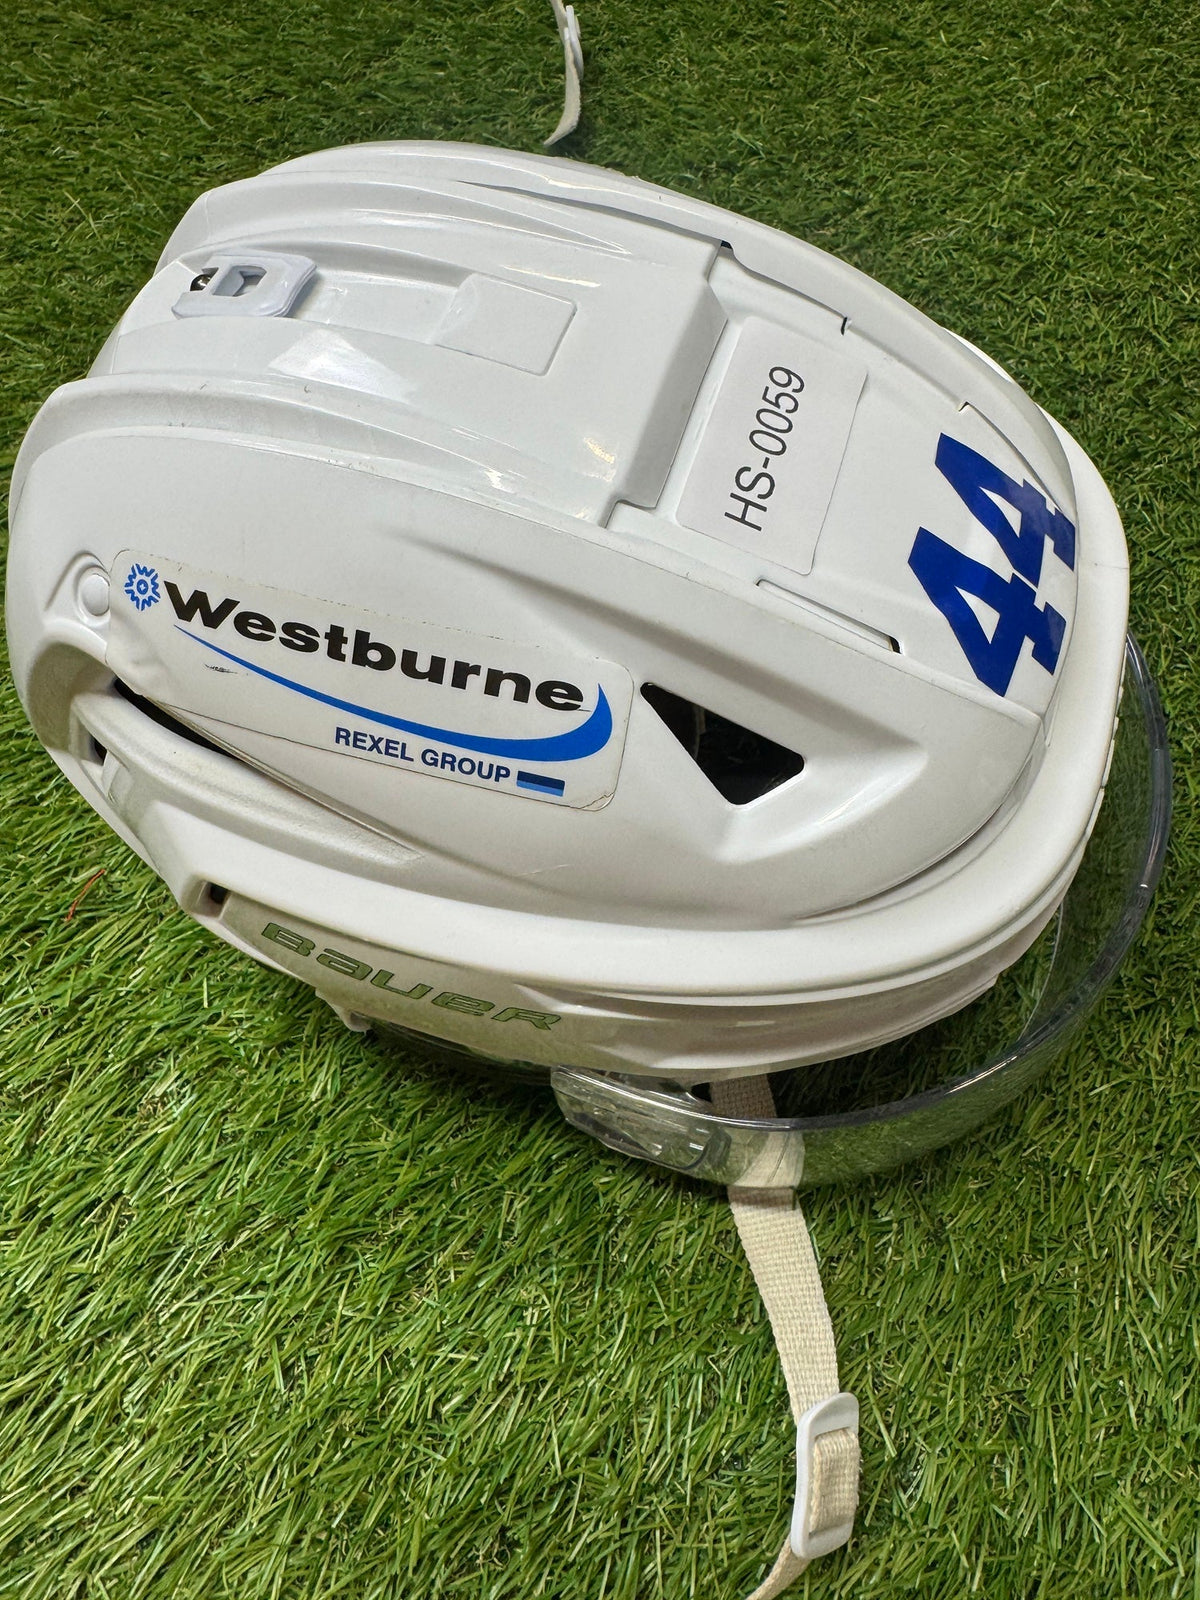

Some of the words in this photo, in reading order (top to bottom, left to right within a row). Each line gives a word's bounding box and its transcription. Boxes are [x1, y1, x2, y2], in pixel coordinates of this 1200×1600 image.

[724, 366, 805, 532] HS-0059
[908, 432, 1076, 697] 44
[164, 580, 584, 711] Westburne
[335, 727, 414, 762] REXEL
[421, 748, 511, 784] GROUP
